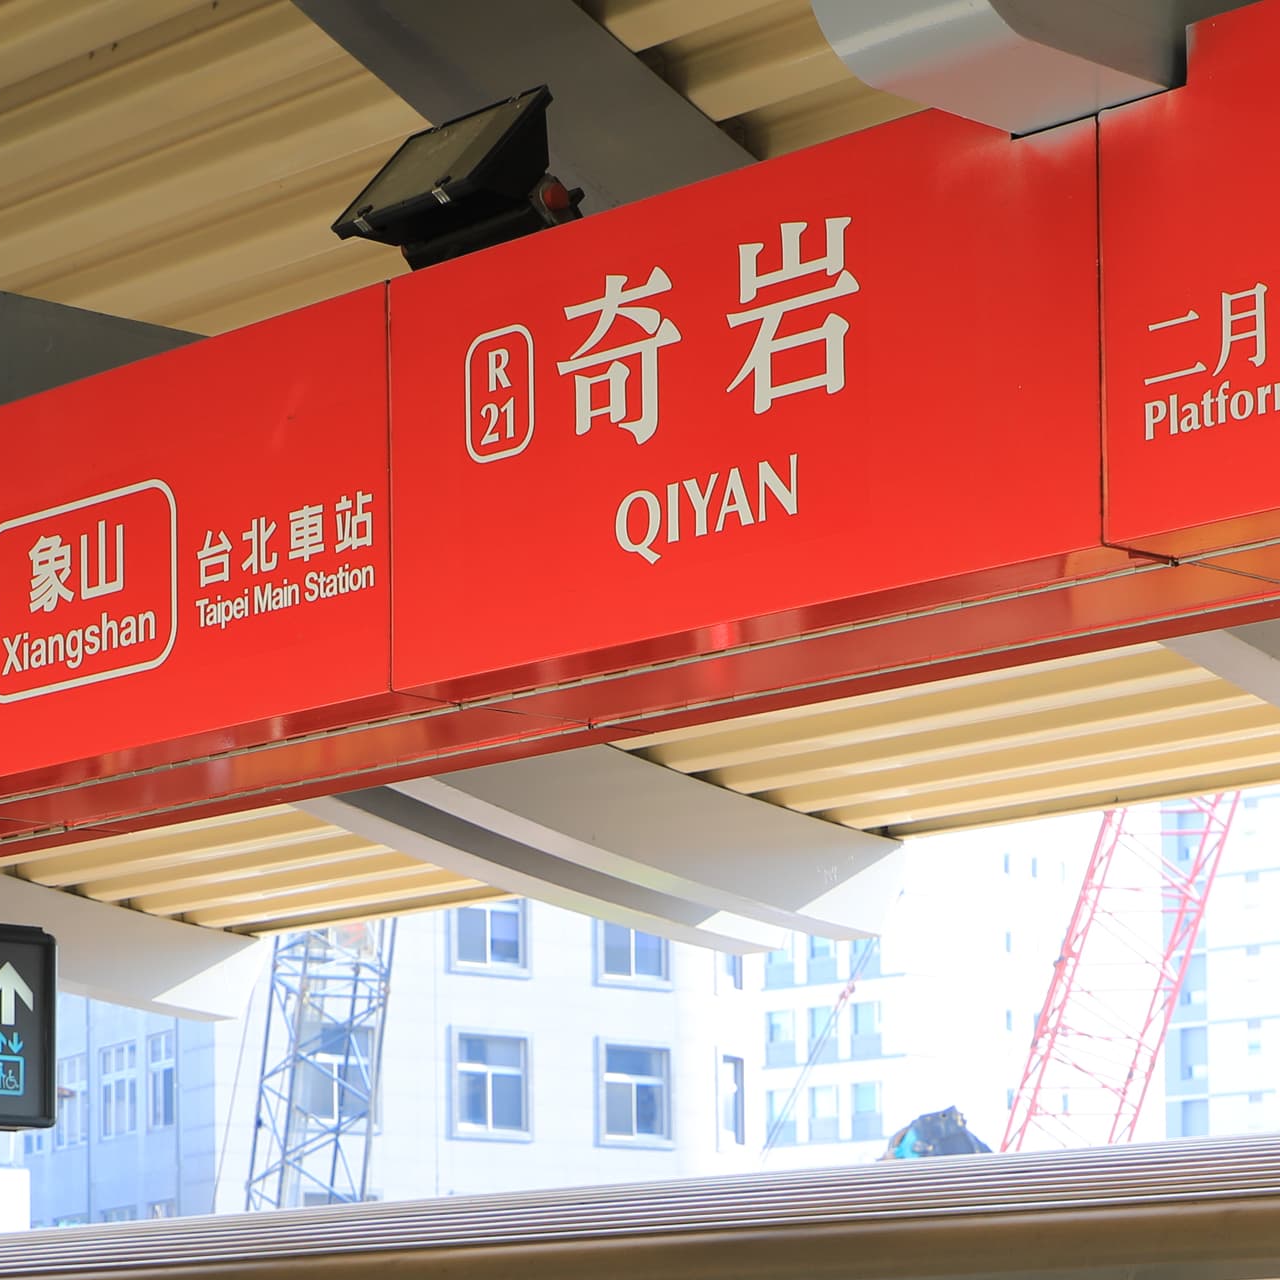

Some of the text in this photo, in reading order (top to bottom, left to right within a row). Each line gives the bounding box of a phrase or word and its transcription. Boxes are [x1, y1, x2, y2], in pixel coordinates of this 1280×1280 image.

[488, 348, 512, 393] R
[557, 216, 861, 446] 奇岩
[479, 399, 517, 446] 21
[196, 490, 375, 589] 台北車站
[614, 453, 800, 565] QIYAN
[28, 520, 125, 613] 象山
[196, 561, 375, 630] Taipei Main Station
[1, 610, 157, 677] Xiangshan
